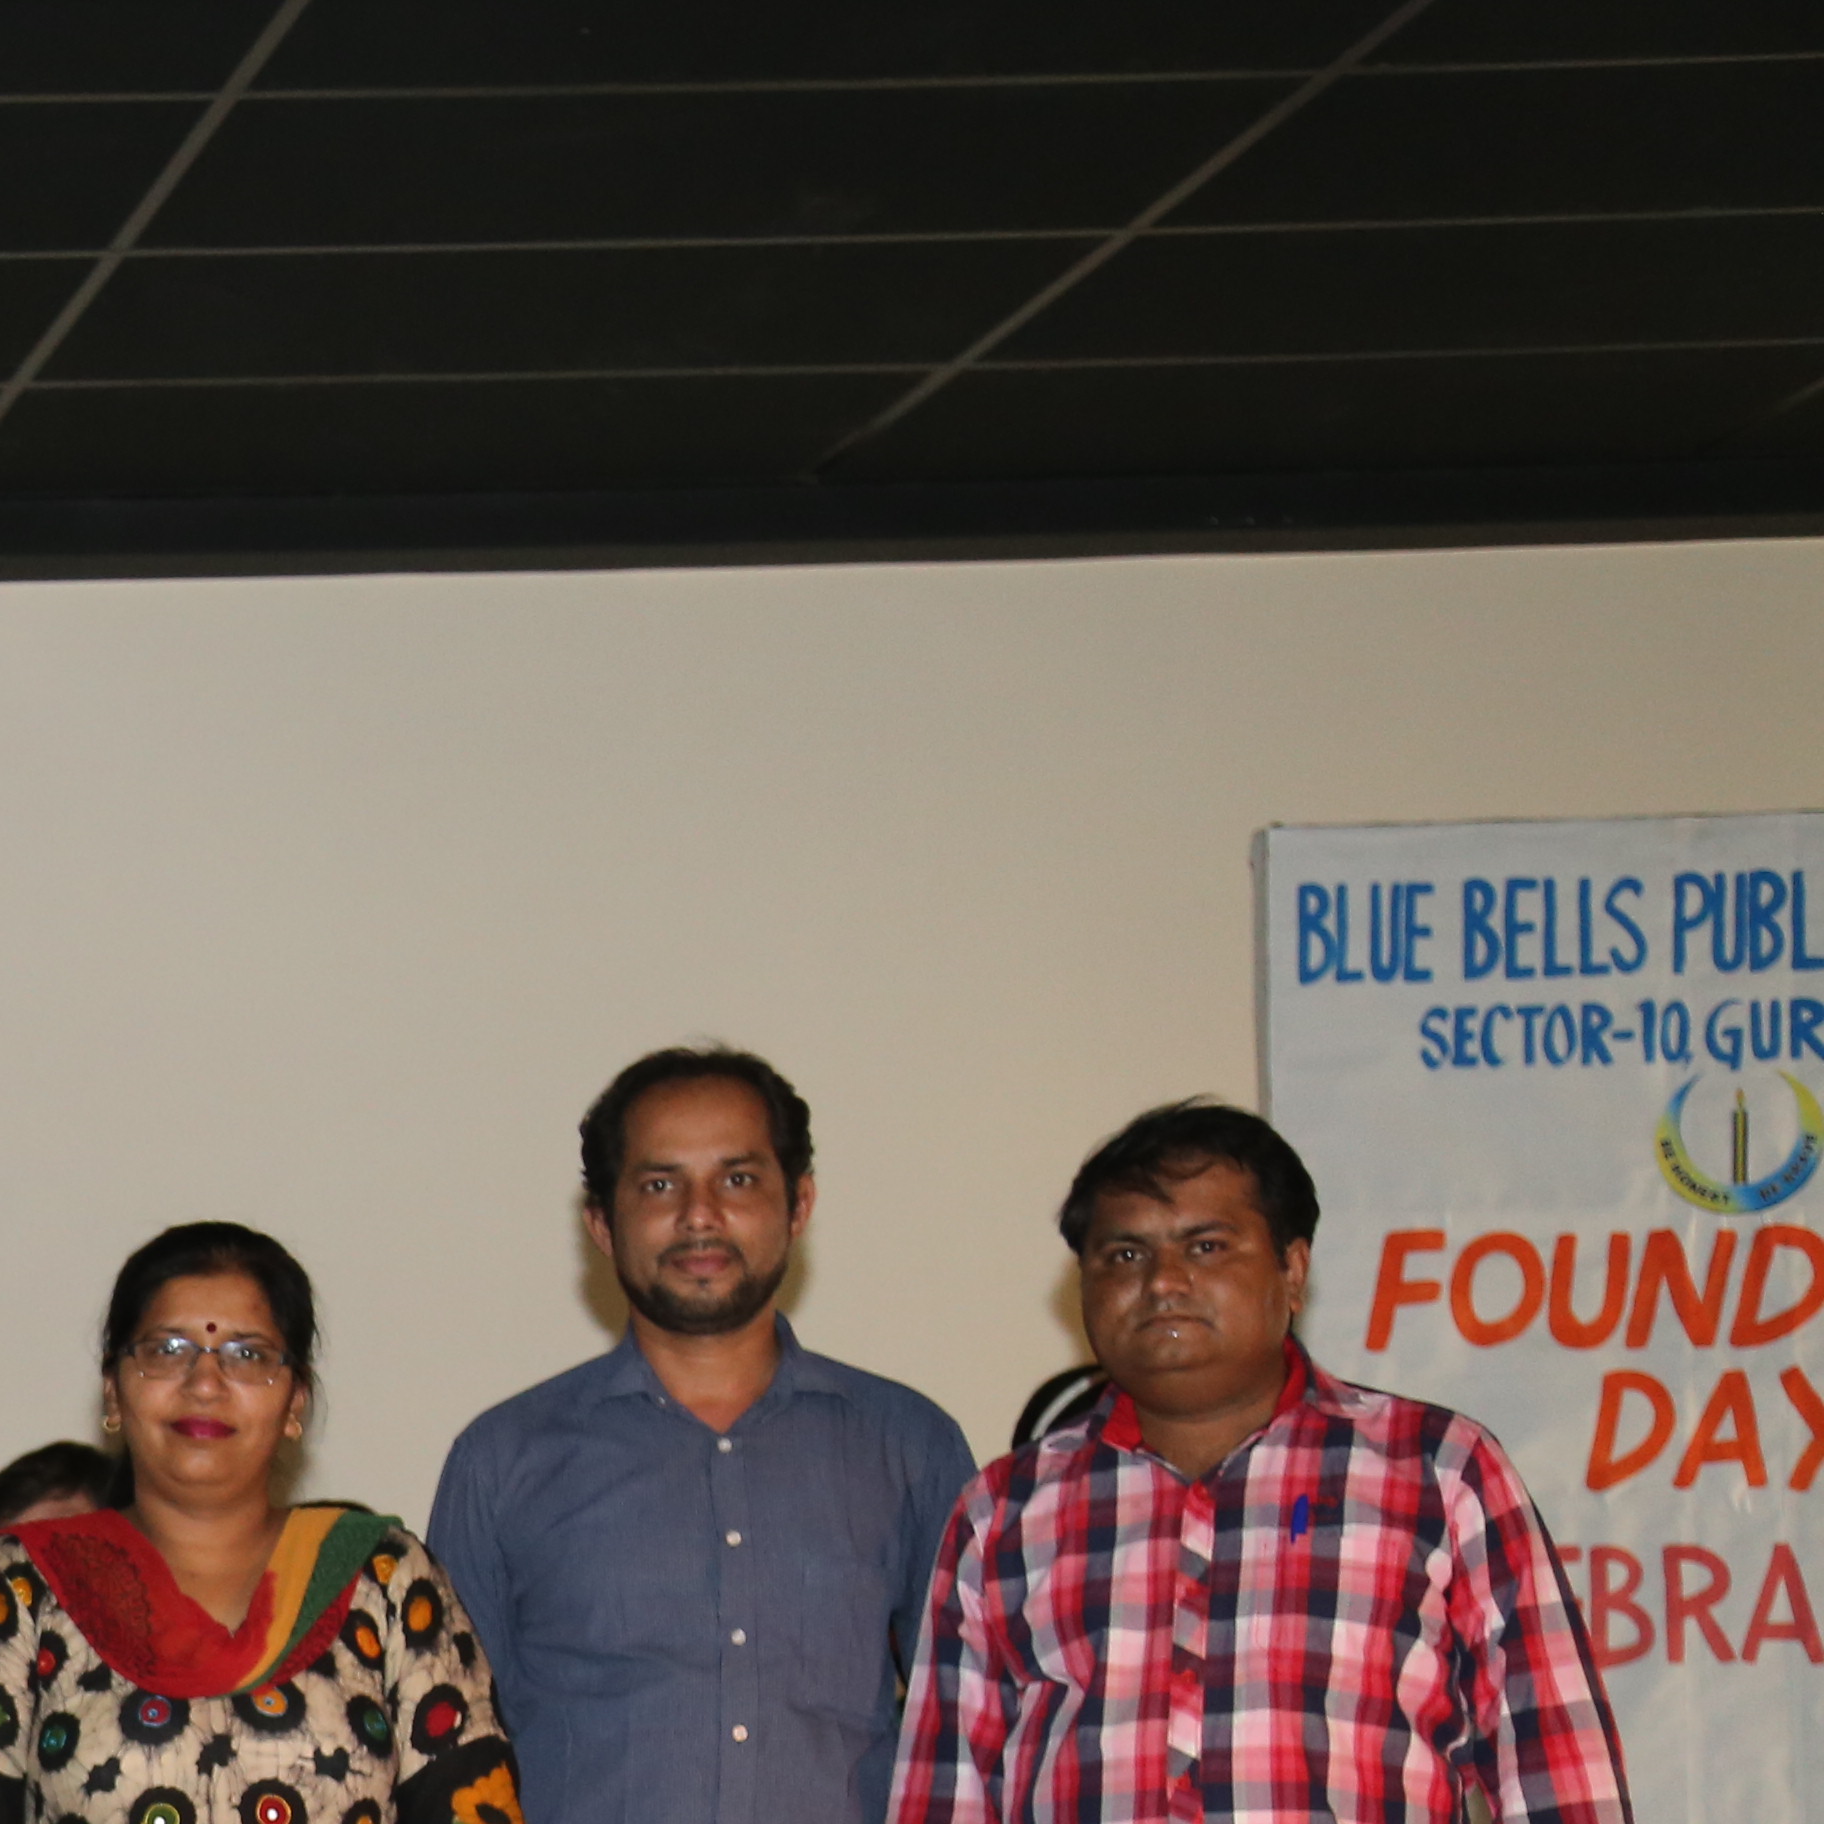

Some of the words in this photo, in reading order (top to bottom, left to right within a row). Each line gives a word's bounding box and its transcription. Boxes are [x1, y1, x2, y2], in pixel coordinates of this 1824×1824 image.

[1297, 881, 1434, 986] BLUE
[1462, 874, 1649, 981] BELLS
[1672, 867, 1824, 975] PUBL
[1705, 997, 1824, 1072] GUR
[1364, 1223, 1824, 1354] FOUND
